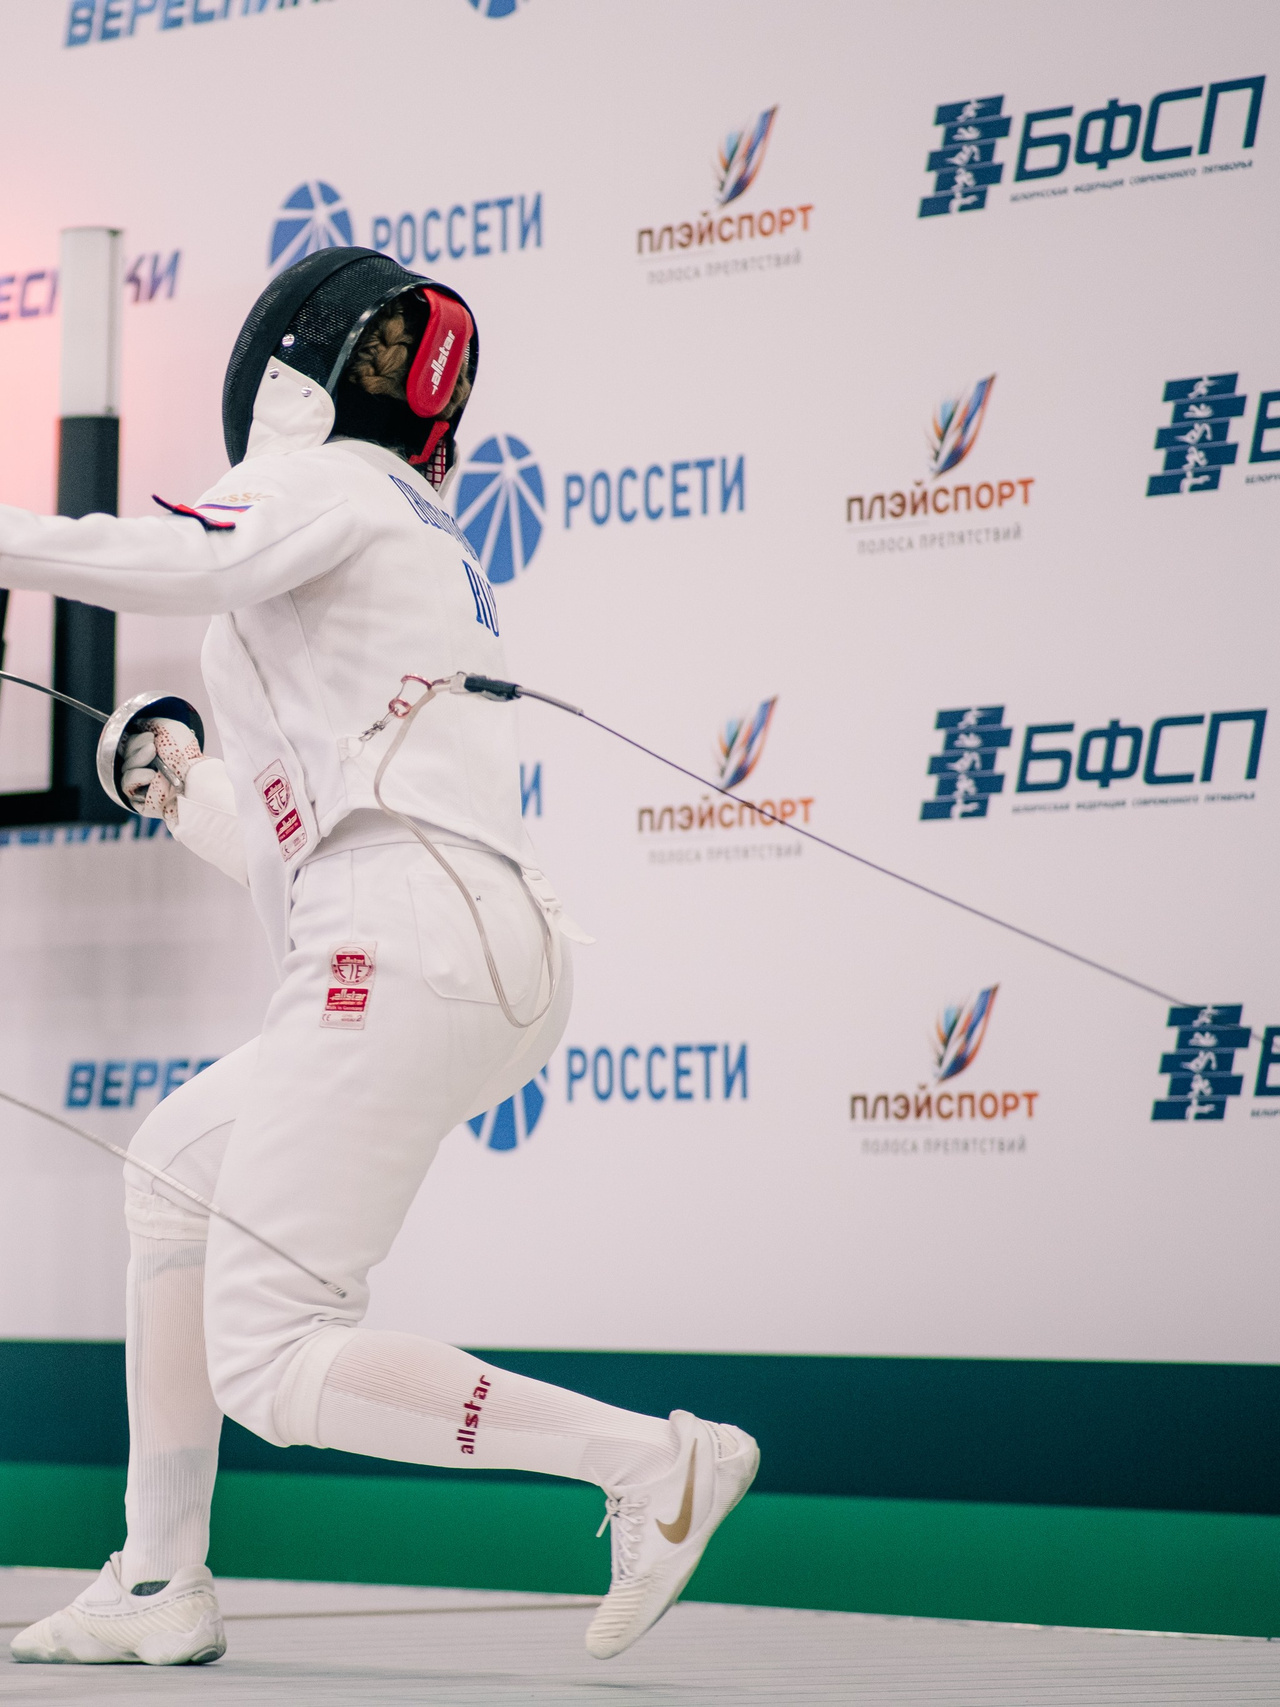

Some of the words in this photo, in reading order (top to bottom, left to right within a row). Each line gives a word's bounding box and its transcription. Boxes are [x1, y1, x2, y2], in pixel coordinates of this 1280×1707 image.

[1014, 75, 1267, 182] БФСП
[372, 191, 543, 266] РОССЕТИ
[637, 204, 815, 254] ПЛЭЙСПОРТ
[647, 266, 701, 286] ПОЛОСА
[705, 247, 802, 278] ПРЕПЯТСТВИЙ
[431, 329, 455, 388] allstar
[564, 454, 745, 530] РОССЕТИ
[846, 477, 1035, 523] ПЛЭЙСПОРТ
[857, 535, 915, 556] ПОЛОСА
[919, 522, 1023, 549] ПРЕПЯТСТВИЙ
[1015, 708, 1267, 793] БФСП
[637, 795, 815, 833] ПЛЭЙСПОРТ
[329, 988, 367, 1001] allstar
[566, 1043, 749, 1103] РОССЕТИ
[849, 1083, 1039, 1121] ПЛЭЙСПОРТ
[861, 1137, 919, 1155] ПОЛОСА
[923, 1134, 1028, 1155] ПРЕПЯТСТВИЙ
[457, 1374, 492, 1455] allstar
